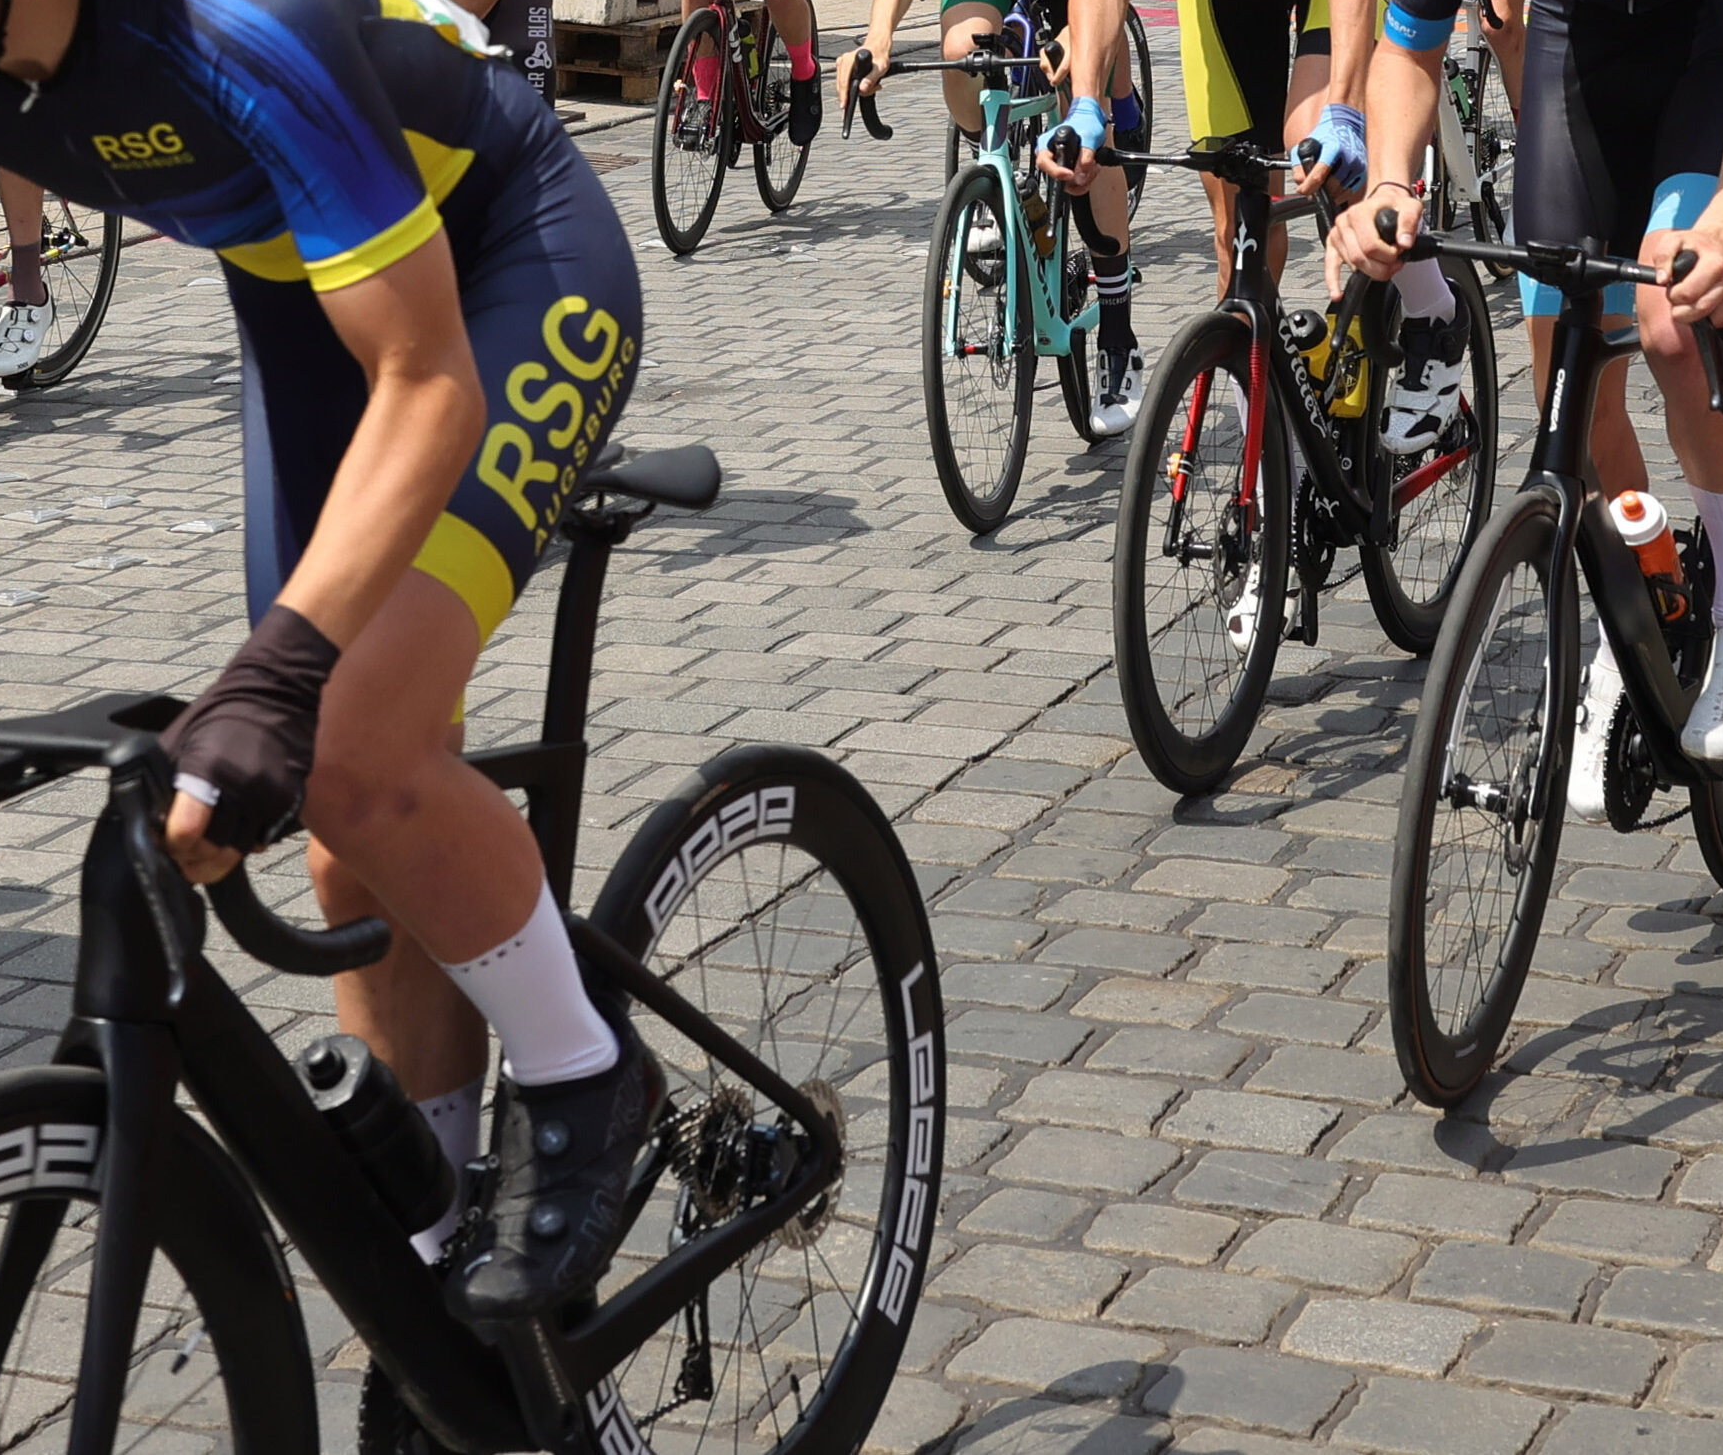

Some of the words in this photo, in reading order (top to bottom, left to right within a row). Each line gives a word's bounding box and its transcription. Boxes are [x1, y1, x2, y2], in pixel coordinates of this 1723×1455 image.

[527, 5, 548, 40] BLAS
[91, 122, 185, 163] RSG
[477, 294, 622, 531] RSG
[533, 334, 637, 558] AUGSBURG
[1548, 367, 1566, 434] ORBEA
[644, 785, 796, 944] eeze
